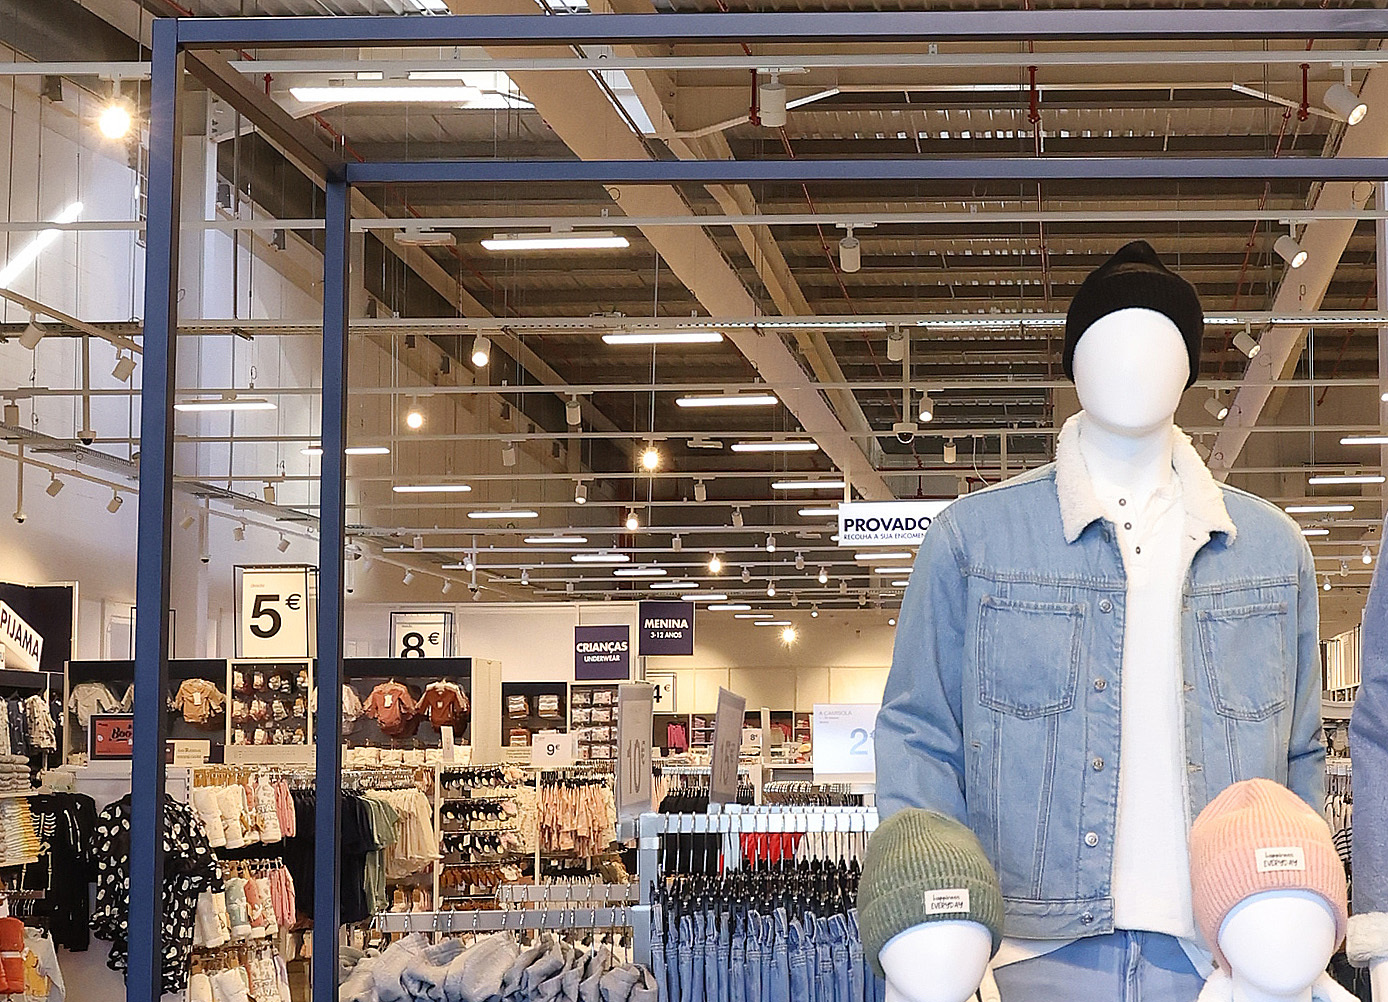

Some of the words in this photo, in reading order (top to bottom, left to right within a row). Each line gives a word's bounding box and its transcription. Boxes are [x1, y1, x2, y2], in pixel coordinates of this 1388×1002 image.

[844, 516, 934, 532] PROVADO
[249, 593, 302, 639] 5€
[643, 618, 689, 629] MENINA
[0, 608, 39, 662] PIJAMA
[664, 631, 682, 639] ANOS
[401, 631, 440, 658] 8€
[576, 641, 628, 653] CRIANÇAS
[583, 654, 621, 663] UNDERWEAR
